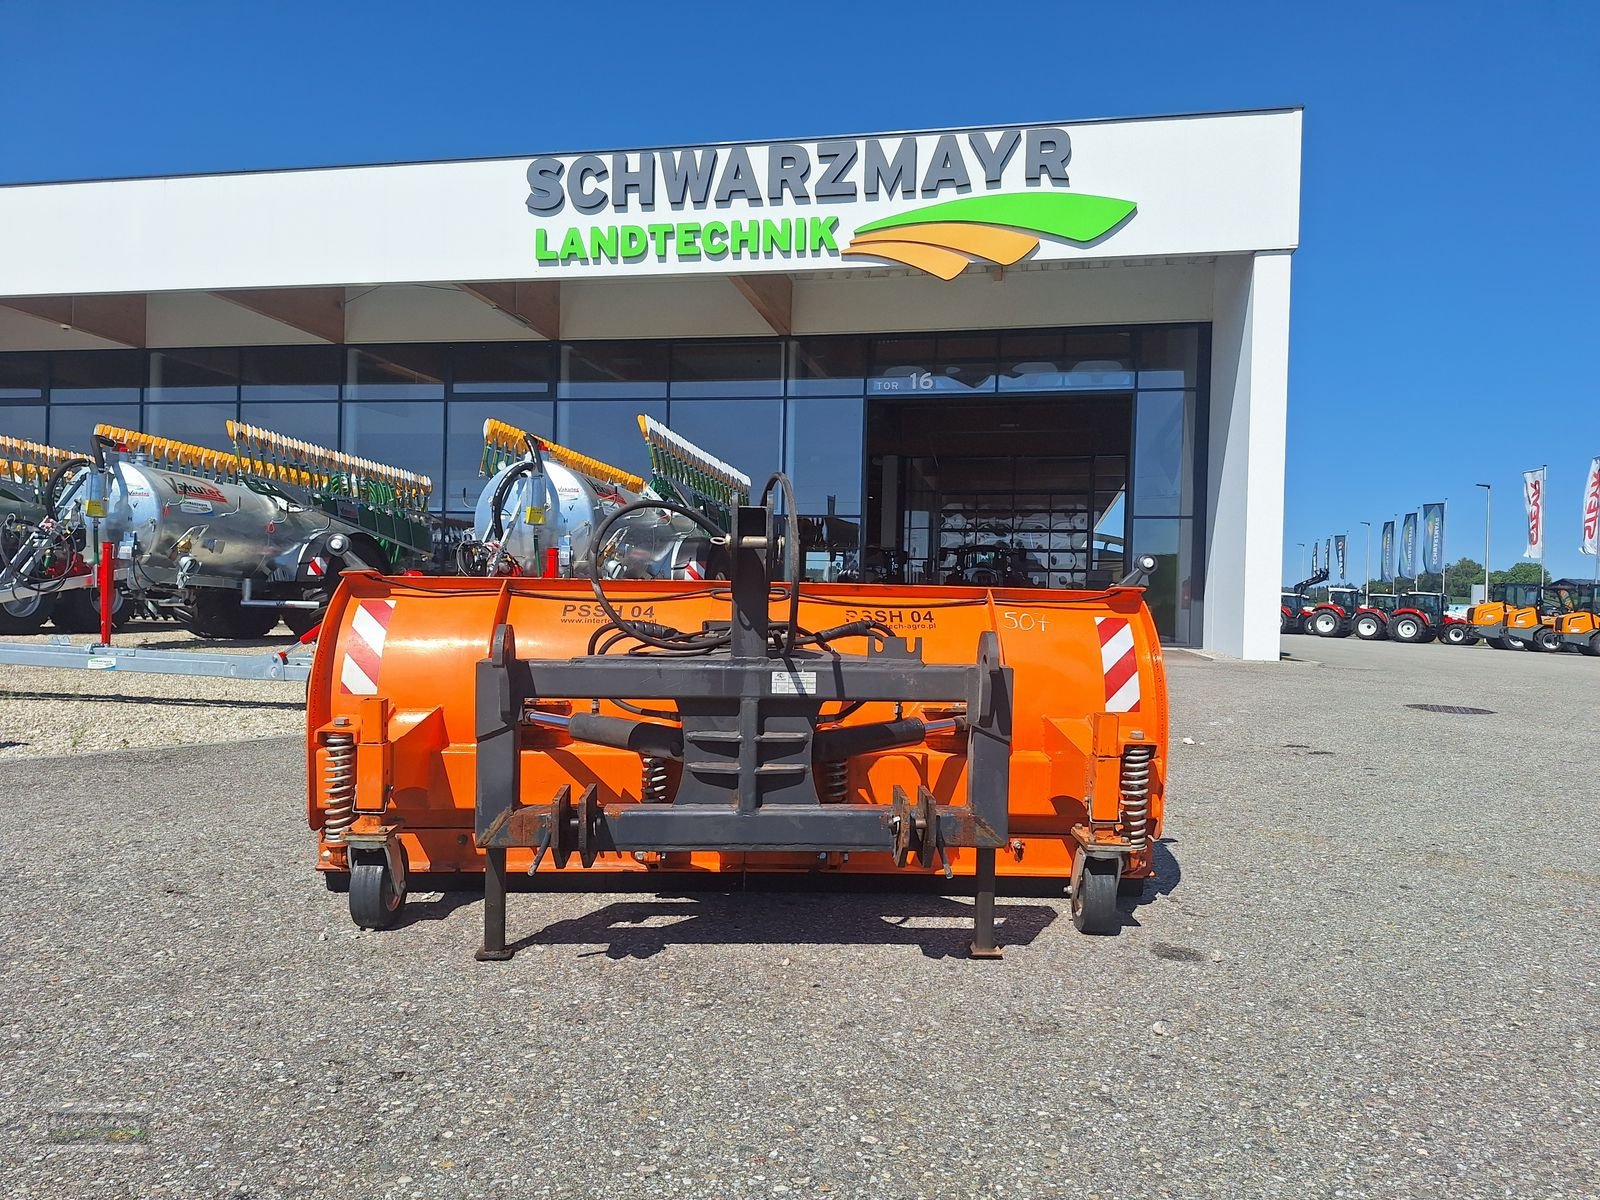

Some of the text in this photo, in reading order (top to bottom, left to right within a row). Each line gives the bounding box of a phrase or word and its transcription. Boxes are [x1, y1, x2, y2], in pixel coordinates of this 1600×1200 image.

[526, 128, 1072, 213] SCHWARZMAYR
[535, 216, 841, 265] LANDTECHNIK
[876, 372, 934, 390] TOR 16
[631, 605, 655, 618] 04
[910, 610, 934, 623] 04
